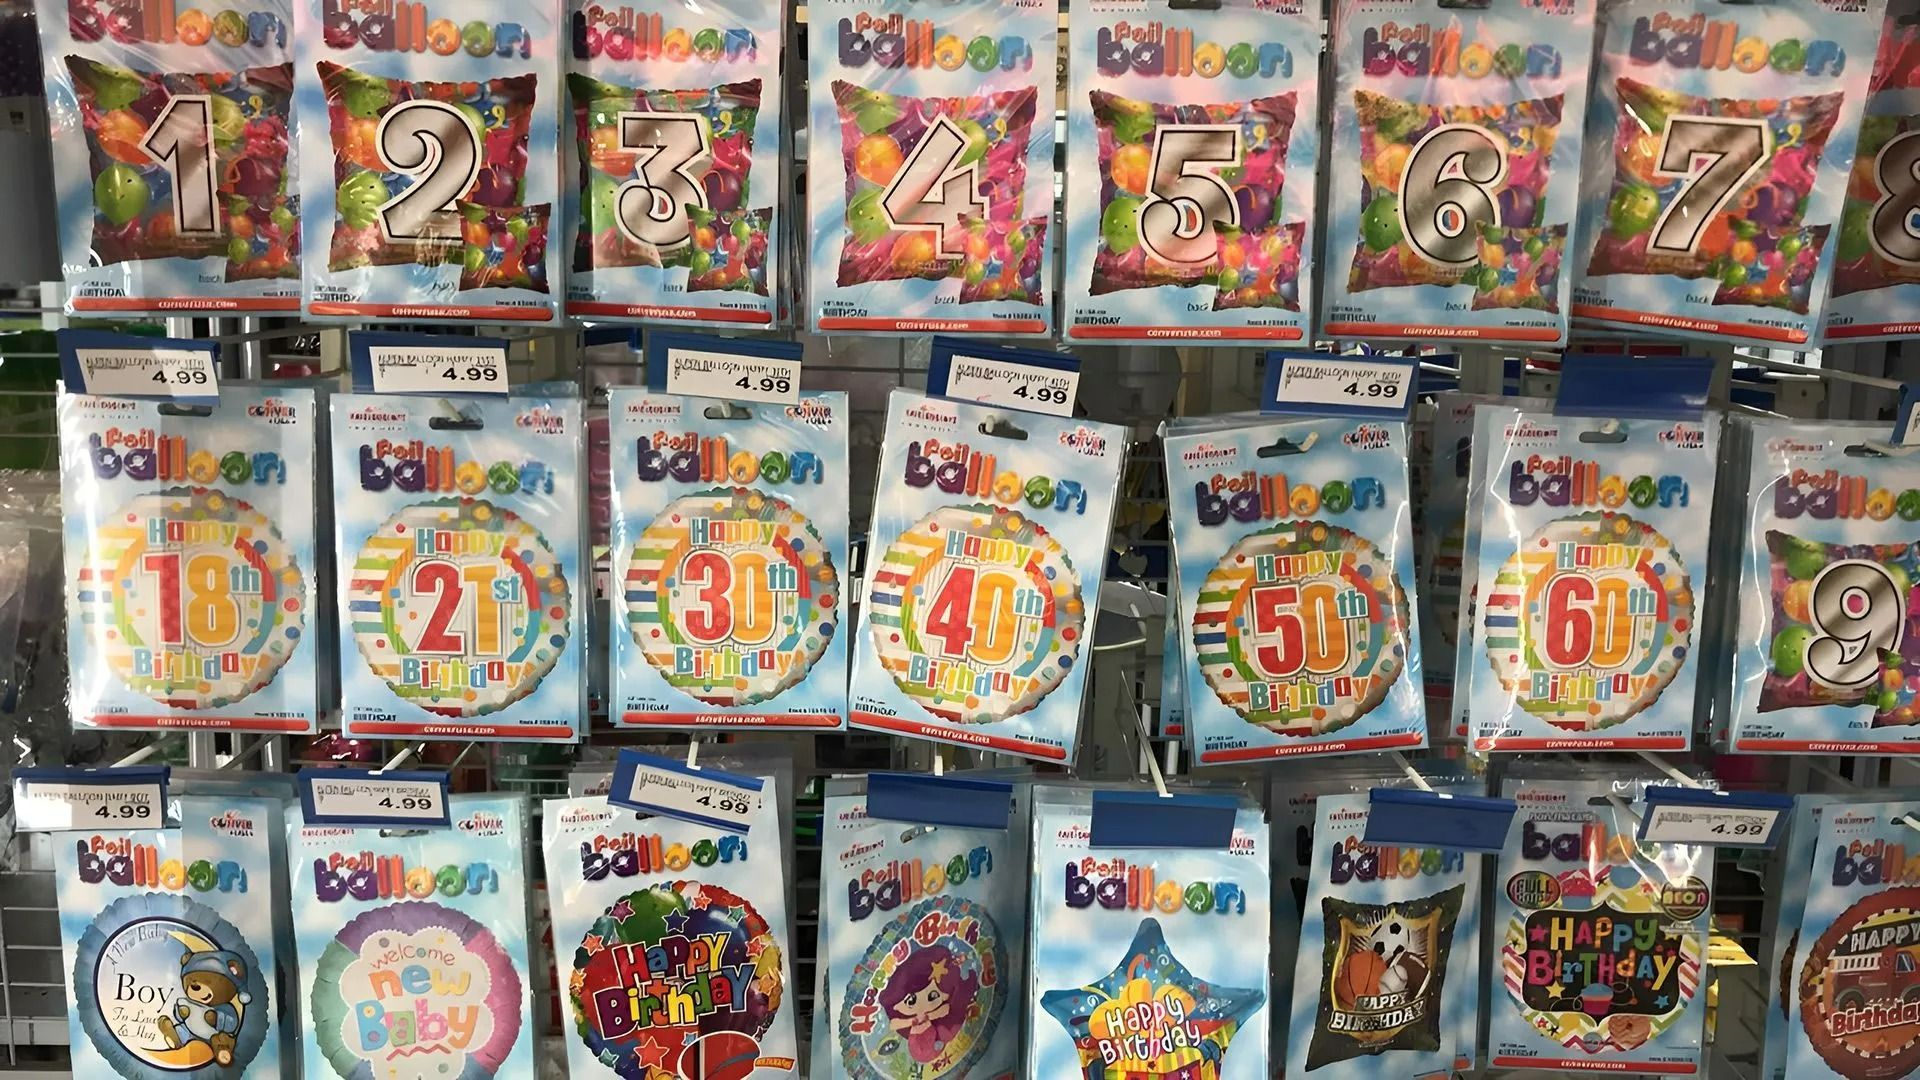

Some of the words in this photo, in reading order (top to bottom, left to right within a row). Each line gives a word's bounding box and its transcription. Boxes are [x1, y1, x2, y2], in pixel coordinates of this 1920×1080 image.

[68, 0, 288, 49] balloon
[322, 0, 531, 58] balloon
[572, 10, 757, 65] balloon
[838, 17, 1033, 73] balloon
[1630, 16, 1847, 78] balloon
[1096, 25, 1293, 79] balloon
[1363, 25, 1562, 79] balloon
[138, 94, 221, 239] 1
[376, 99, 482, 245] 2
[613, 111, 712, 250] 3
[880, 113, 989, 260] 4
[1646, 114, 1771, 259] 7
[1136, 124, 1243, 268] 5
[1398, 123, 1508, 268] 6
[152, 370, 207, 384] 4.99
[442, 366, 498, 381] 4.99
[735, 376, 791, 394] 4.99
[1013, 385, 1067, 404] 4.99
[1343, 382, 1399, 399] 4.99
[88, 432, 288, 485] balloon
[358, 444, 555, 494] balloon
[636, 435, 824, 484] balloon
[903, 440, 1089, 517] balloon
[1194, 474, 1387, 526] balloon
[1508, 459, 1690, 510] balloon
[1774, 474, 1920, 522] balloo
[147, 517, 238, 547] Happy
[415, 527, 505, 557] Happy
[689, 516, 777, 547] Happy
[945, 529, 1034, 568] Happy
[1556, 541, 1642, 570] Happy
[1254, 550, 1344, 583] Happy
[140, 552, 261, 648] 18th
[413, 559, 522, 656] 21st
[682, 549, 798, 645] 30th
[925, 565, 1047, 664] 40th
[1543, 572, 1658, 669] 60th
[1250, 579, 1369, 678] 50th
[1803, 557, 1906, 691] 9
[133, 648, 257, 682] Birthday
[401, 654, 532, 692] Birthday
[674, 646, 794, 681] Birthday
[908, 654, 1030, 701] Birthday
[1530, 669, 1646, 706] Birthday
[1247, 672, 1370, 714] Birthday
[95, 804, 151, 819] 4.99
[379, 797, 432, 811] 4.99
[696, 795, 749, 816] 4.99
[1711, 823, 1764, 836] 4.99
[77, 839, 248, 893] balloon
[315, 855, 500, 902] balloon
[579, 835, 747, 882] balloon
[1330, 841, 1464, 885] balloon
[1832, 844, 1920, 887] ballo
[847, 845, 994, 922] balloon
[1065, 860, 1247, 915] balloon
[370, 943, 456, 969] welcome
[114, 972, 175, 1014] Boy
[368, 964, 472, 1001] new
[355, 998, 480, 1052] Baby
[1104, 993, 1186, 1039] Happy
[1831, 998, 1920, 1037] Birthda
[1099, 1019, 1203, 1066] Birthday
